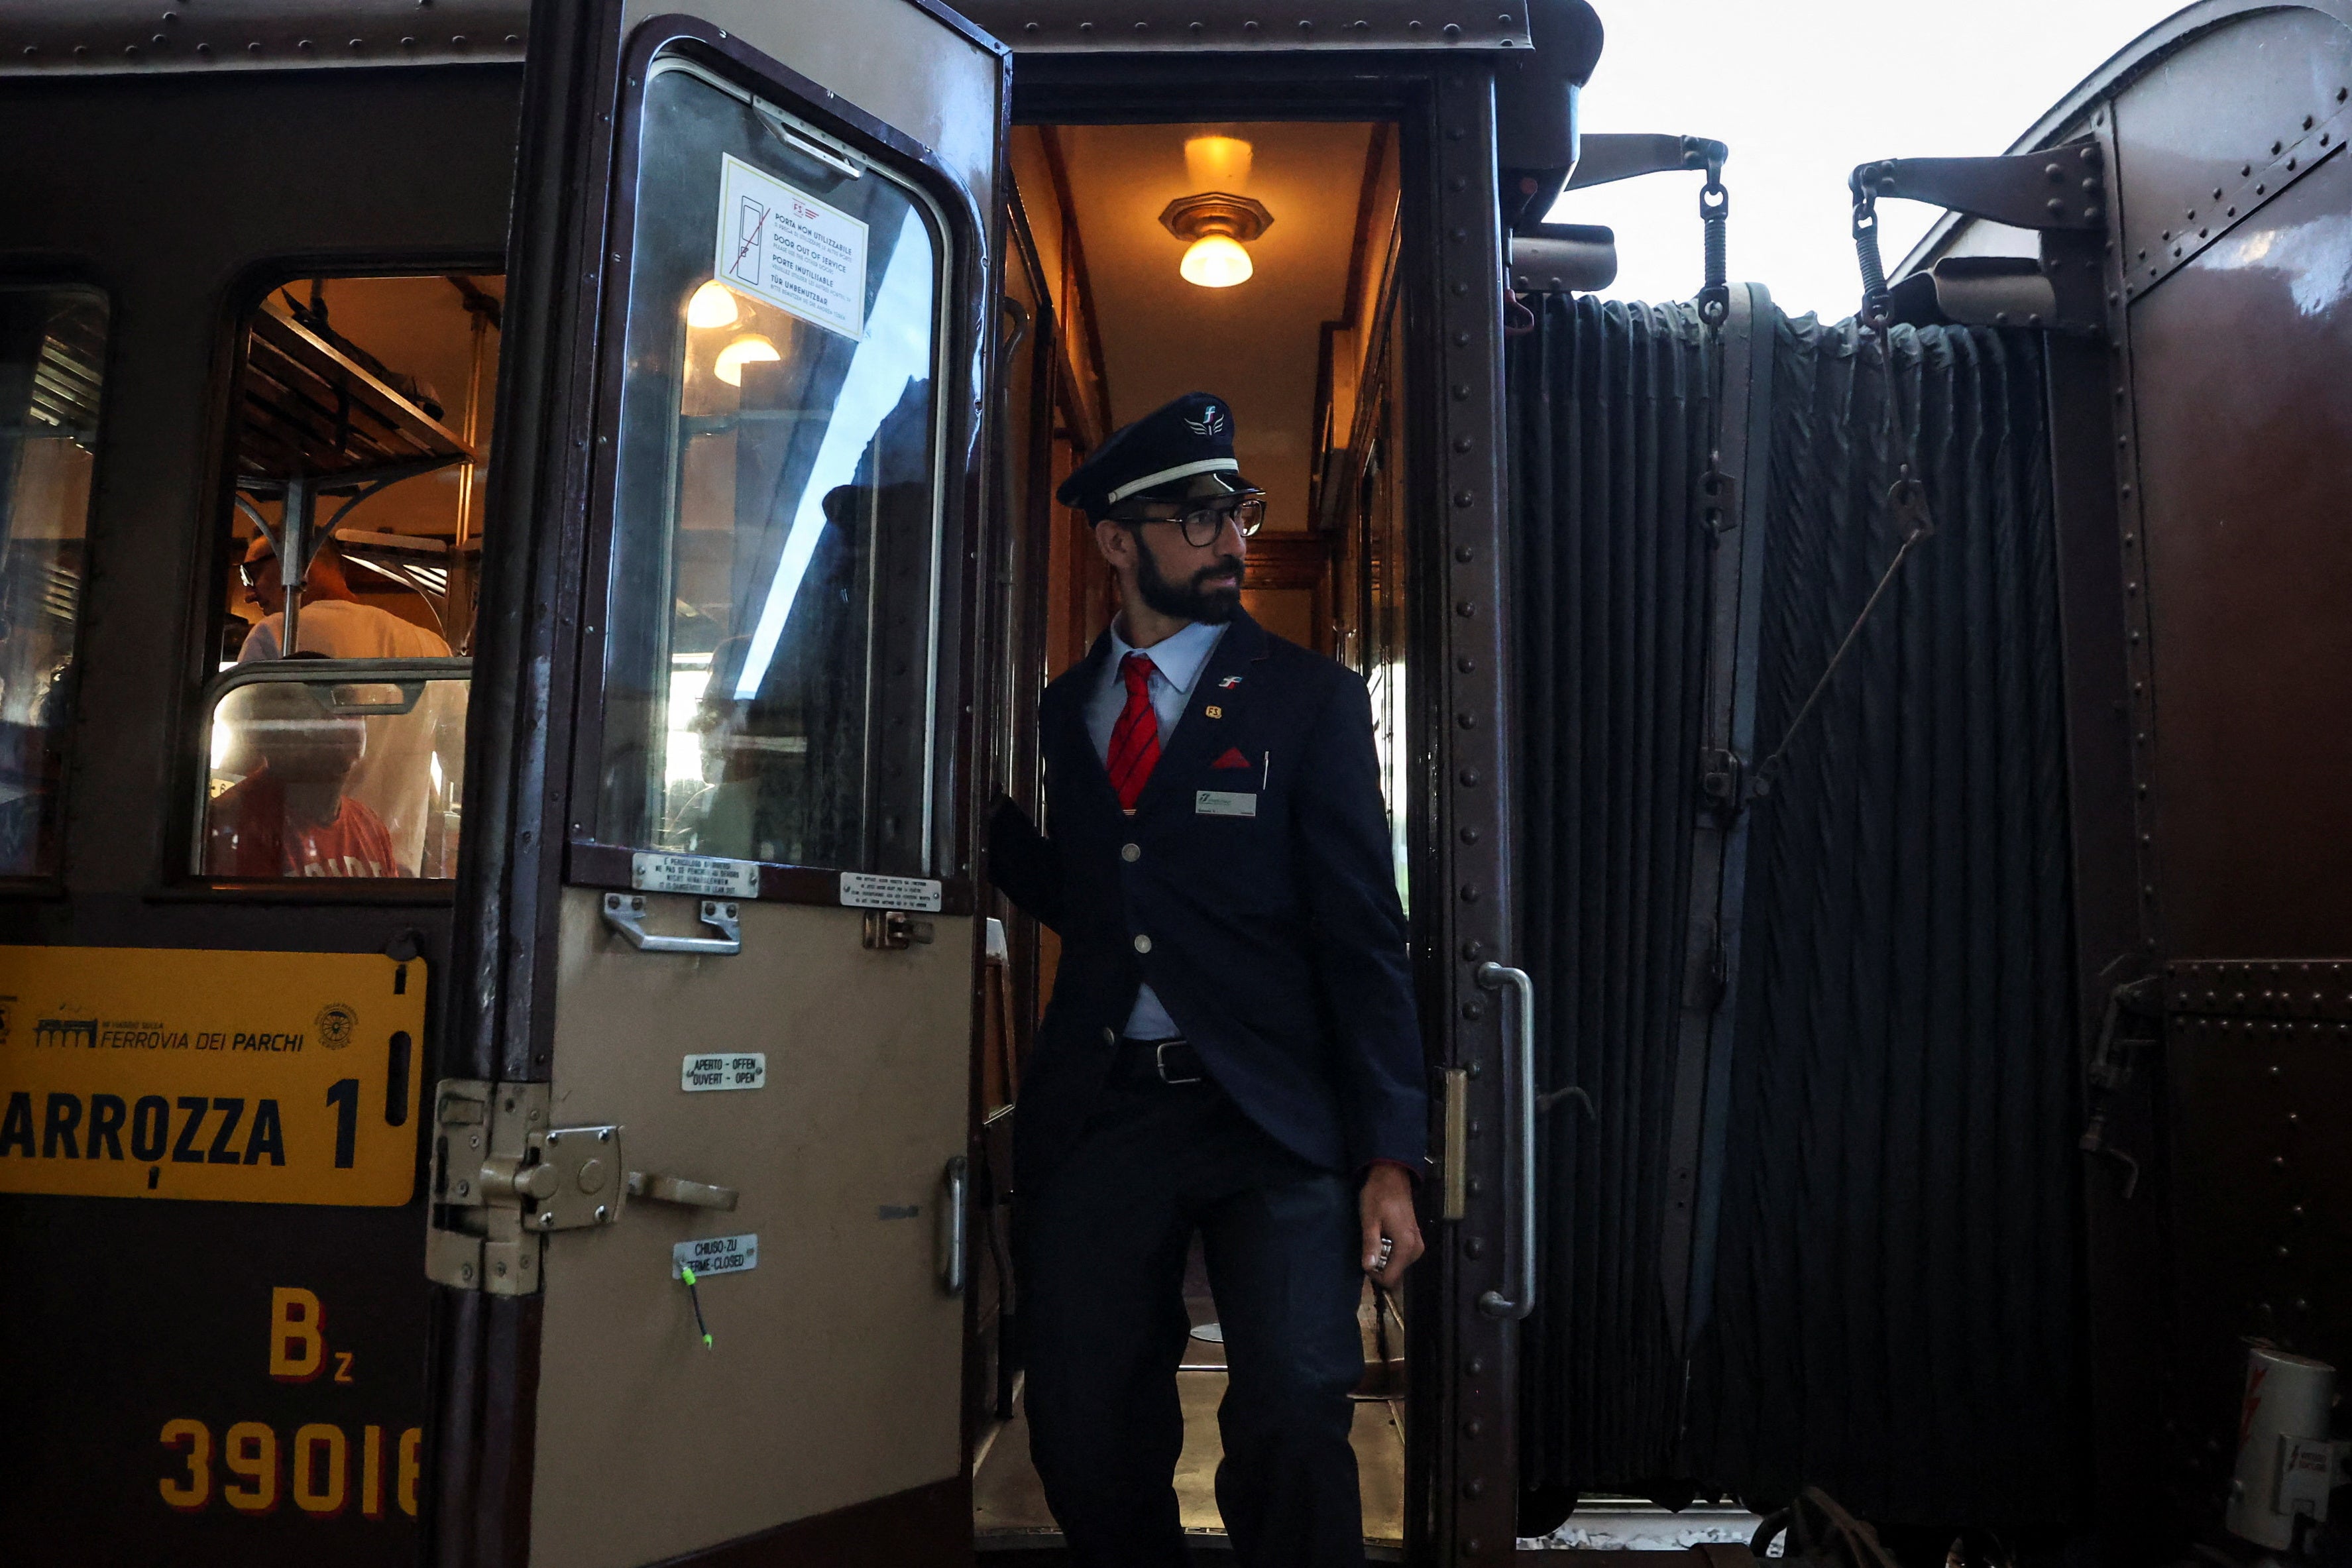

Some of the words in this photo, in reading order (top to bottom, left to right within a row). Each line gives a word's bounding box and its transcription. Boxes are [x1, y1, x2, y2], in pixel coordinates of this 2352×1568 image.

[775, 212, 795, 229] PORTA
[797, 223, 812, 237] NON
[813, 231, 852, 255] UTILIZZABILE
[773, 233, 794, 249] DOOR
[796, 243, 809, 256] OUT
[811, 250, 820, 261] OF
[822, 255, 846, 273] SERVICE
[772, 253, 793, 270] PORTE
[795, 264, 833, 288] INUTILISABLE
[771, 272, 783, 286] TÜR
[785, 280, 827, 306] UNBENUTZBAR
[101, 1031, 189, 1050] FERROVIA
[196, 1033, 226, 1050] DEI
[232, 1033, 304, 1052] PARCHI
[693, 1073, 722, 1086] OUVERT
[736, 1072, 755, 1084] OPEN
[695, 1059, 722, 1070] APERTO
[732, 1058, 756, 1070] OFFEN
[325, 1079, 359, 1169] 1
